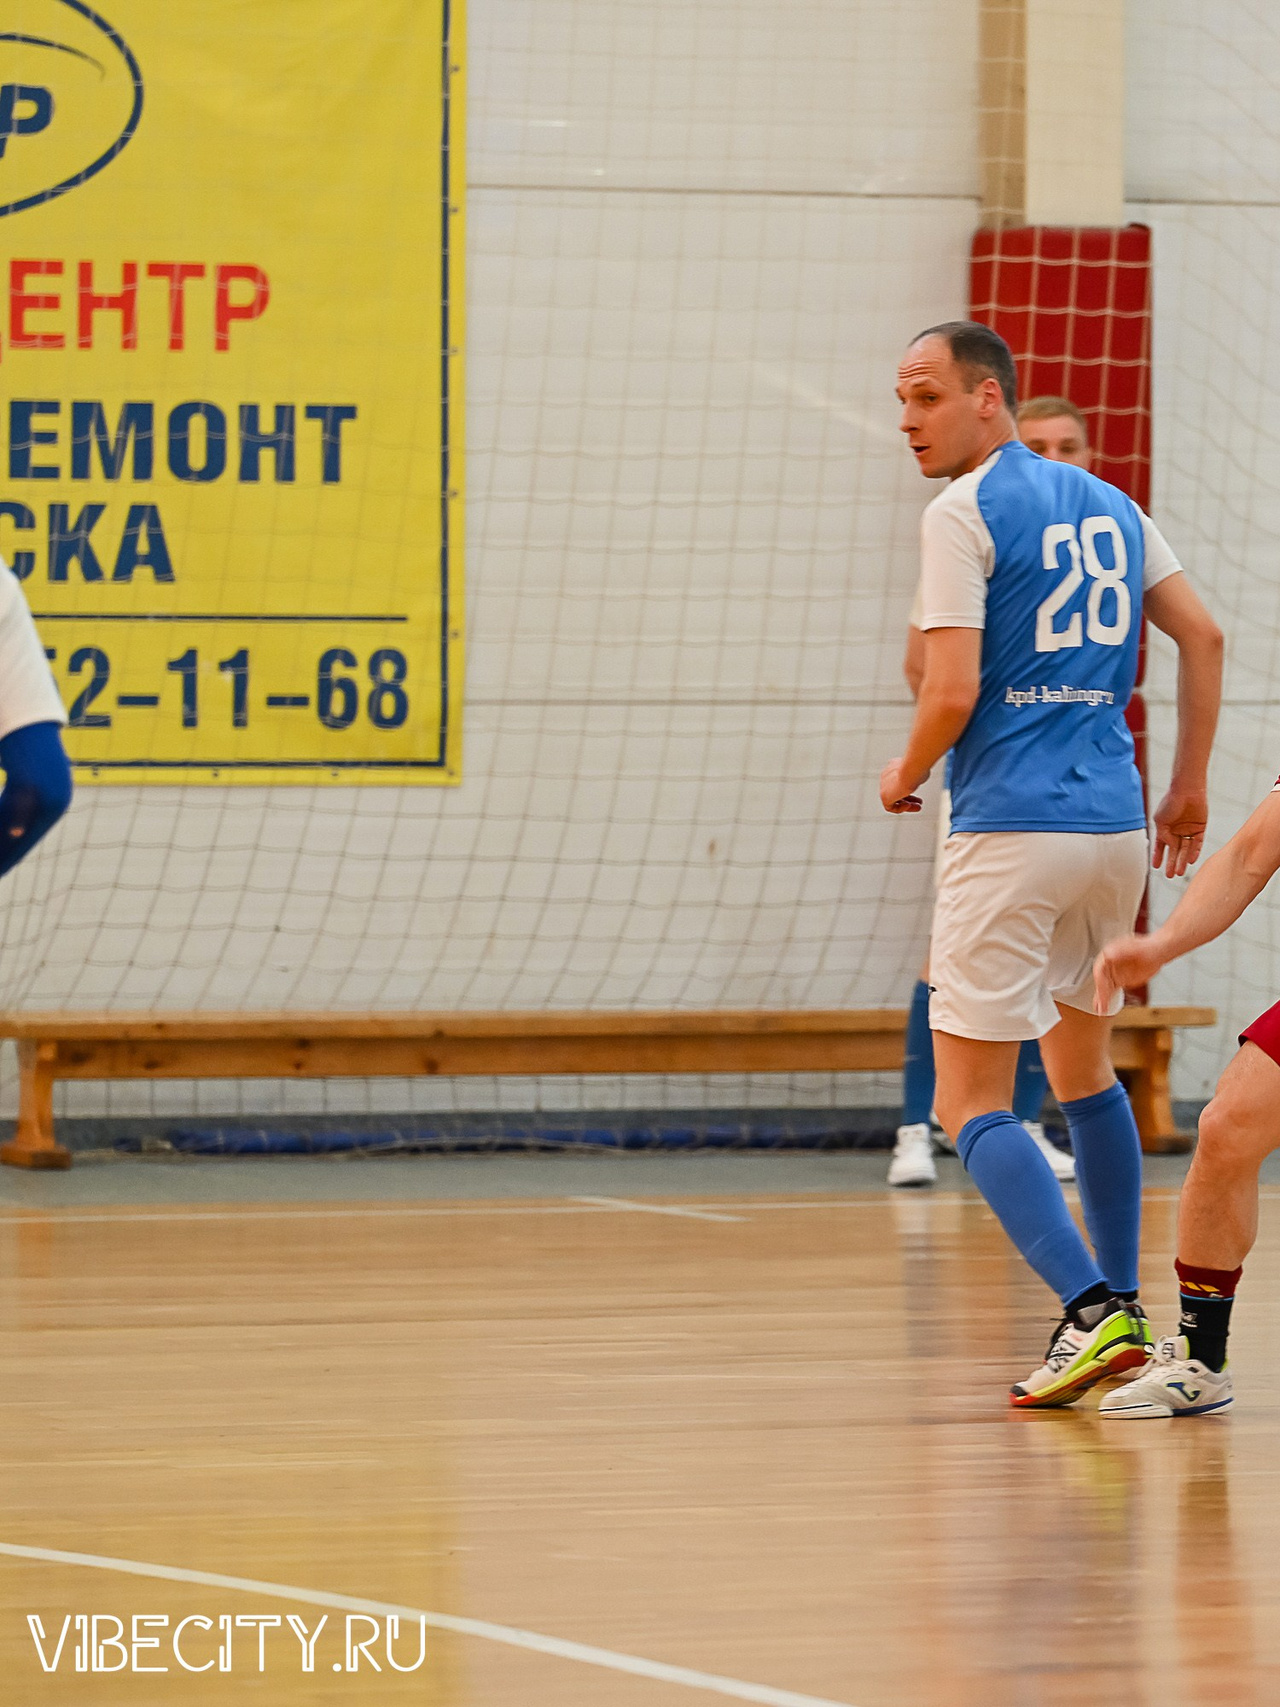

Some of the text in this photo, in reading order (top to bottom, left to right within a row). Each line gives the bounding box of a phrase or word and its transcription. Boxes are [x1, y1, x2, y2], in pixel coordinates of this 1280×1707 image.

[0, 259, 271, 363] ЕНТР
[9, 398, 357, 484] ЕМОНТ
[1035, 516, 1131, 652] 28
